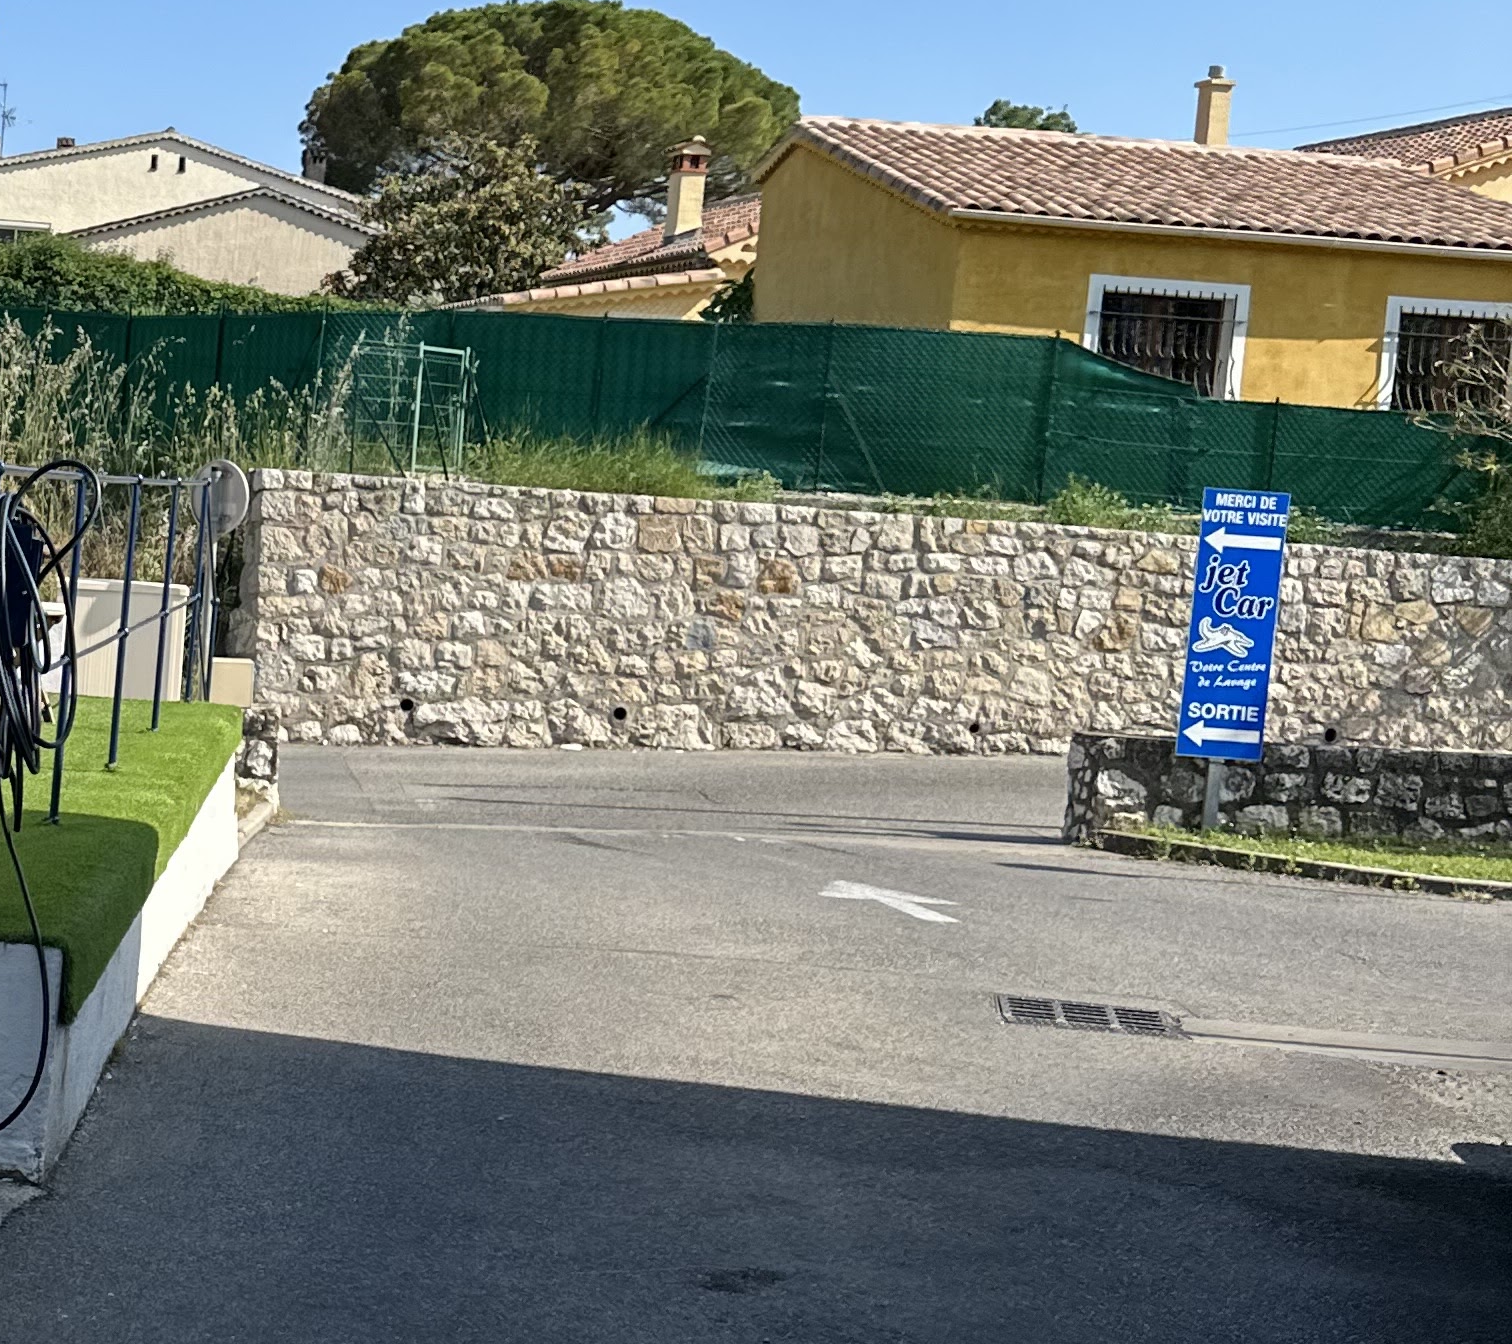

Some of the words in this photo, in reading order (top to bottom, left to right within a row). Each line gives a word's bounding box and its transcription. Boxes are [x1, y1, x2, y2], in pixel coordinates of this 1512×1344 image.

[1215, 492, 1257, 509] MERCI
[1259, 496, 1278, 510] DE
[1203, 508, 1244, 525] VOTRE
[1247, 511, 1288, 528] VISITE
[1199, 554, 1250, 594] jet
[1212, 585, 1275, 620] Car
[1189, 660, 1224, 673] Votre
[1227, 659, 1267, 673] Centre
[1197, 675, 1211, 688] de
[1213, 674, 1257, 691] Lavage
[1188, 702, 1260, 723] SORTIE
